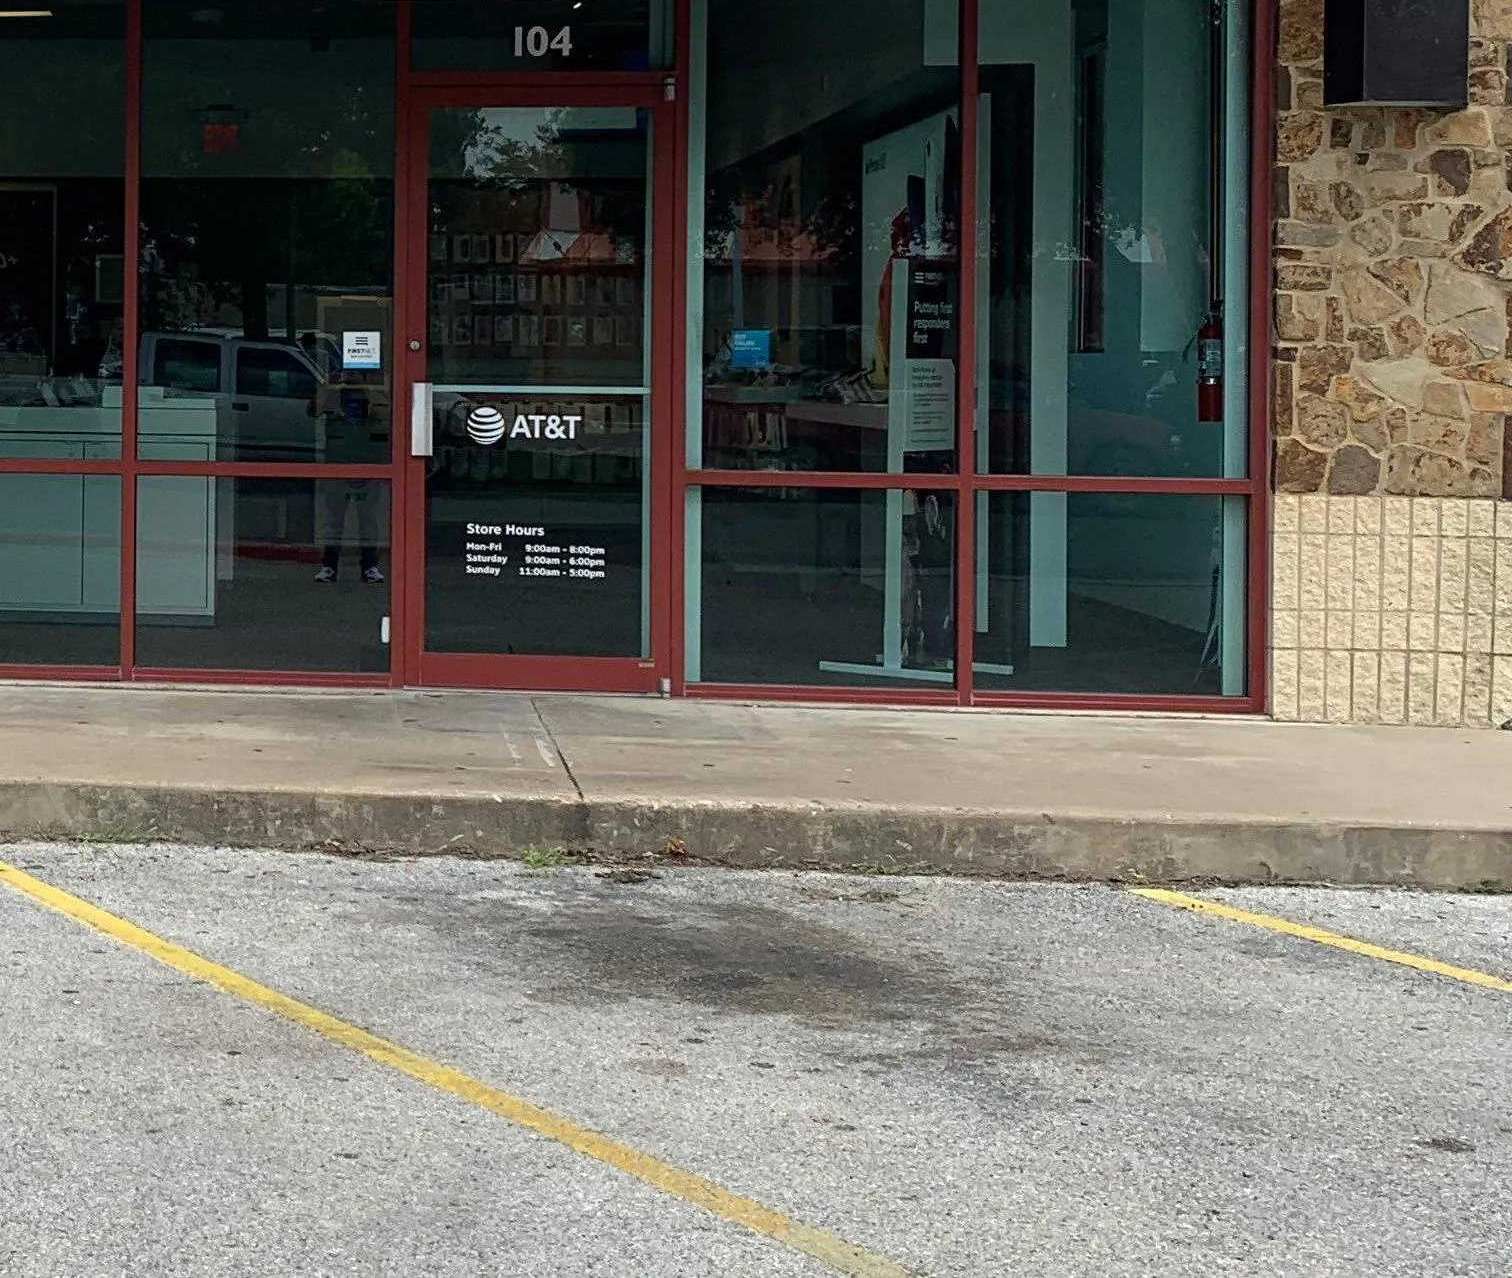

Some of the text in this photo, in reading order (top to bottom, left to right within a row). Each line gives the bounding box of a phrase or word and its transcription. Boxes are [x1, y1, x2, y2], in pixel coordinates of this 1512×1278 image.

[514, 25, 573, 57] 104
[509, 414, 582, 440] AT&T
[466, 523, 545, 537] Store Hours
[465, 542, 502, 551] Mon-Fri
[524, 544, 560, 554] 9:00am
[465, 553, 508, 565] Saturday
[569, 556, 605, 567] 6:00pm
[465, 565, 500, 576] Sunday
[519, 567, 560, 576] 11:00am
